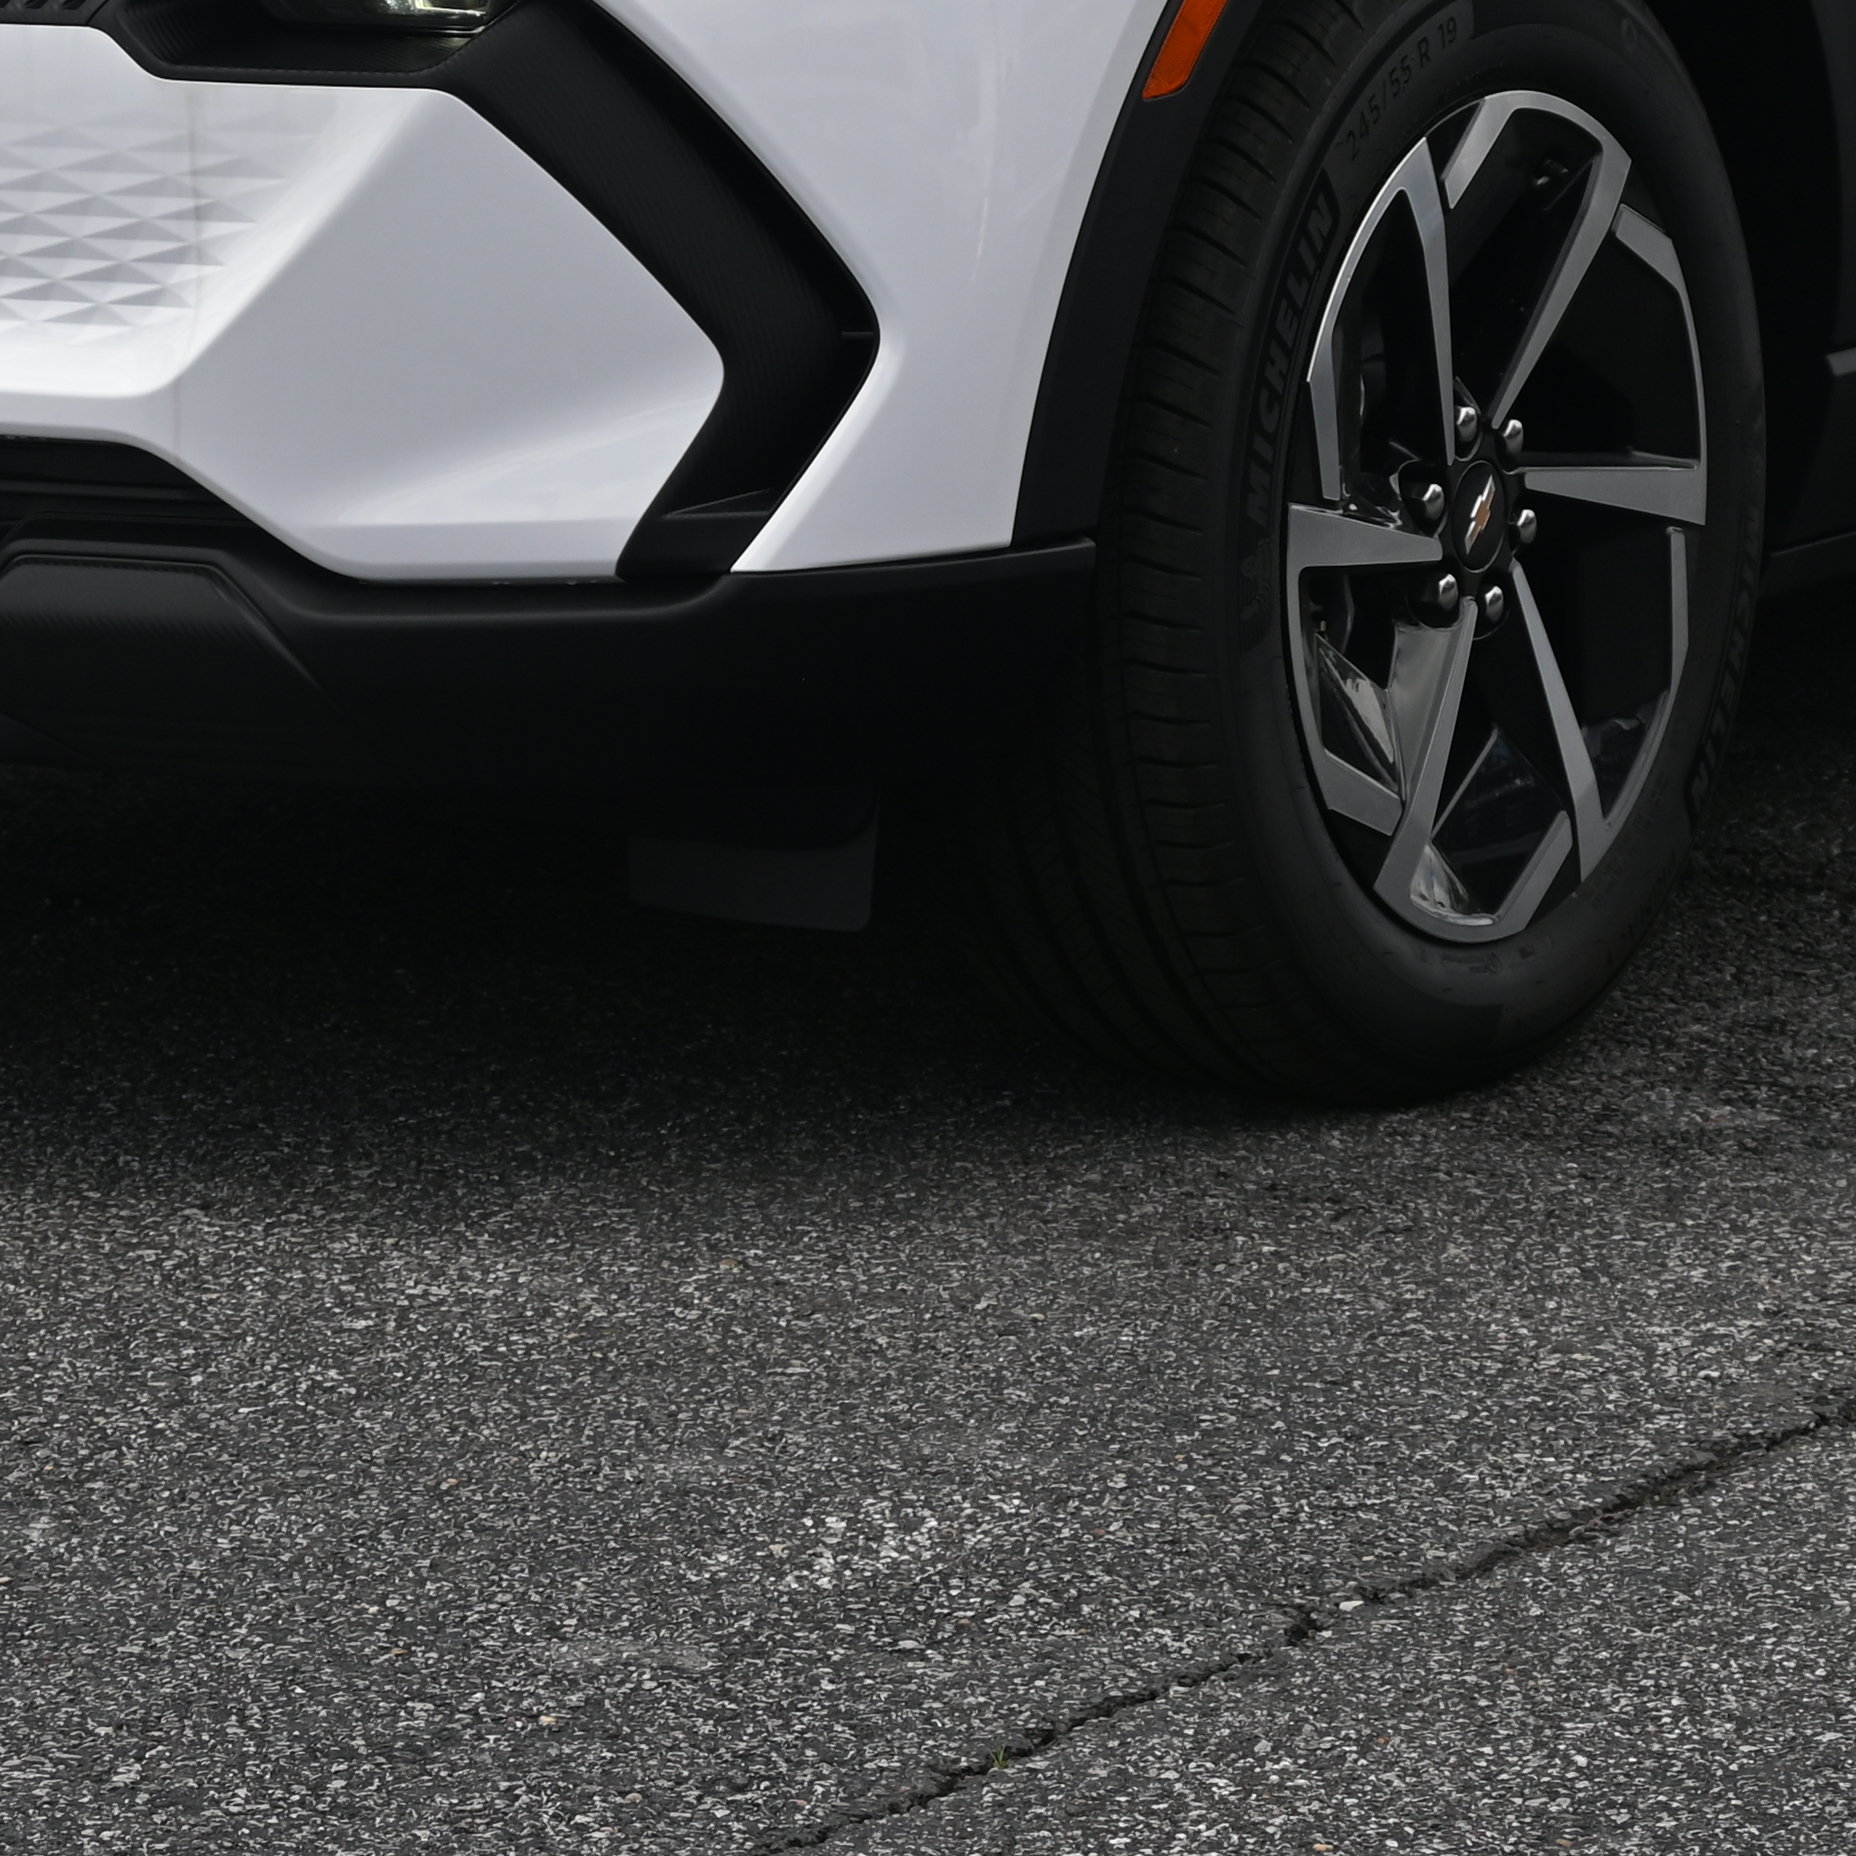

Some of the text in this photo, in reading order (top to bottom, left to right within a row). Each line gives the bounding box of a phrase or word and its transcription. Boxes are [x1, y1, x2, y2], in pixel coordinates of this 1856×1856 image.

[1345, 15, 1458, 162] 245/55 R 19
[1246, 187, 1337, 530] MICHELIN
